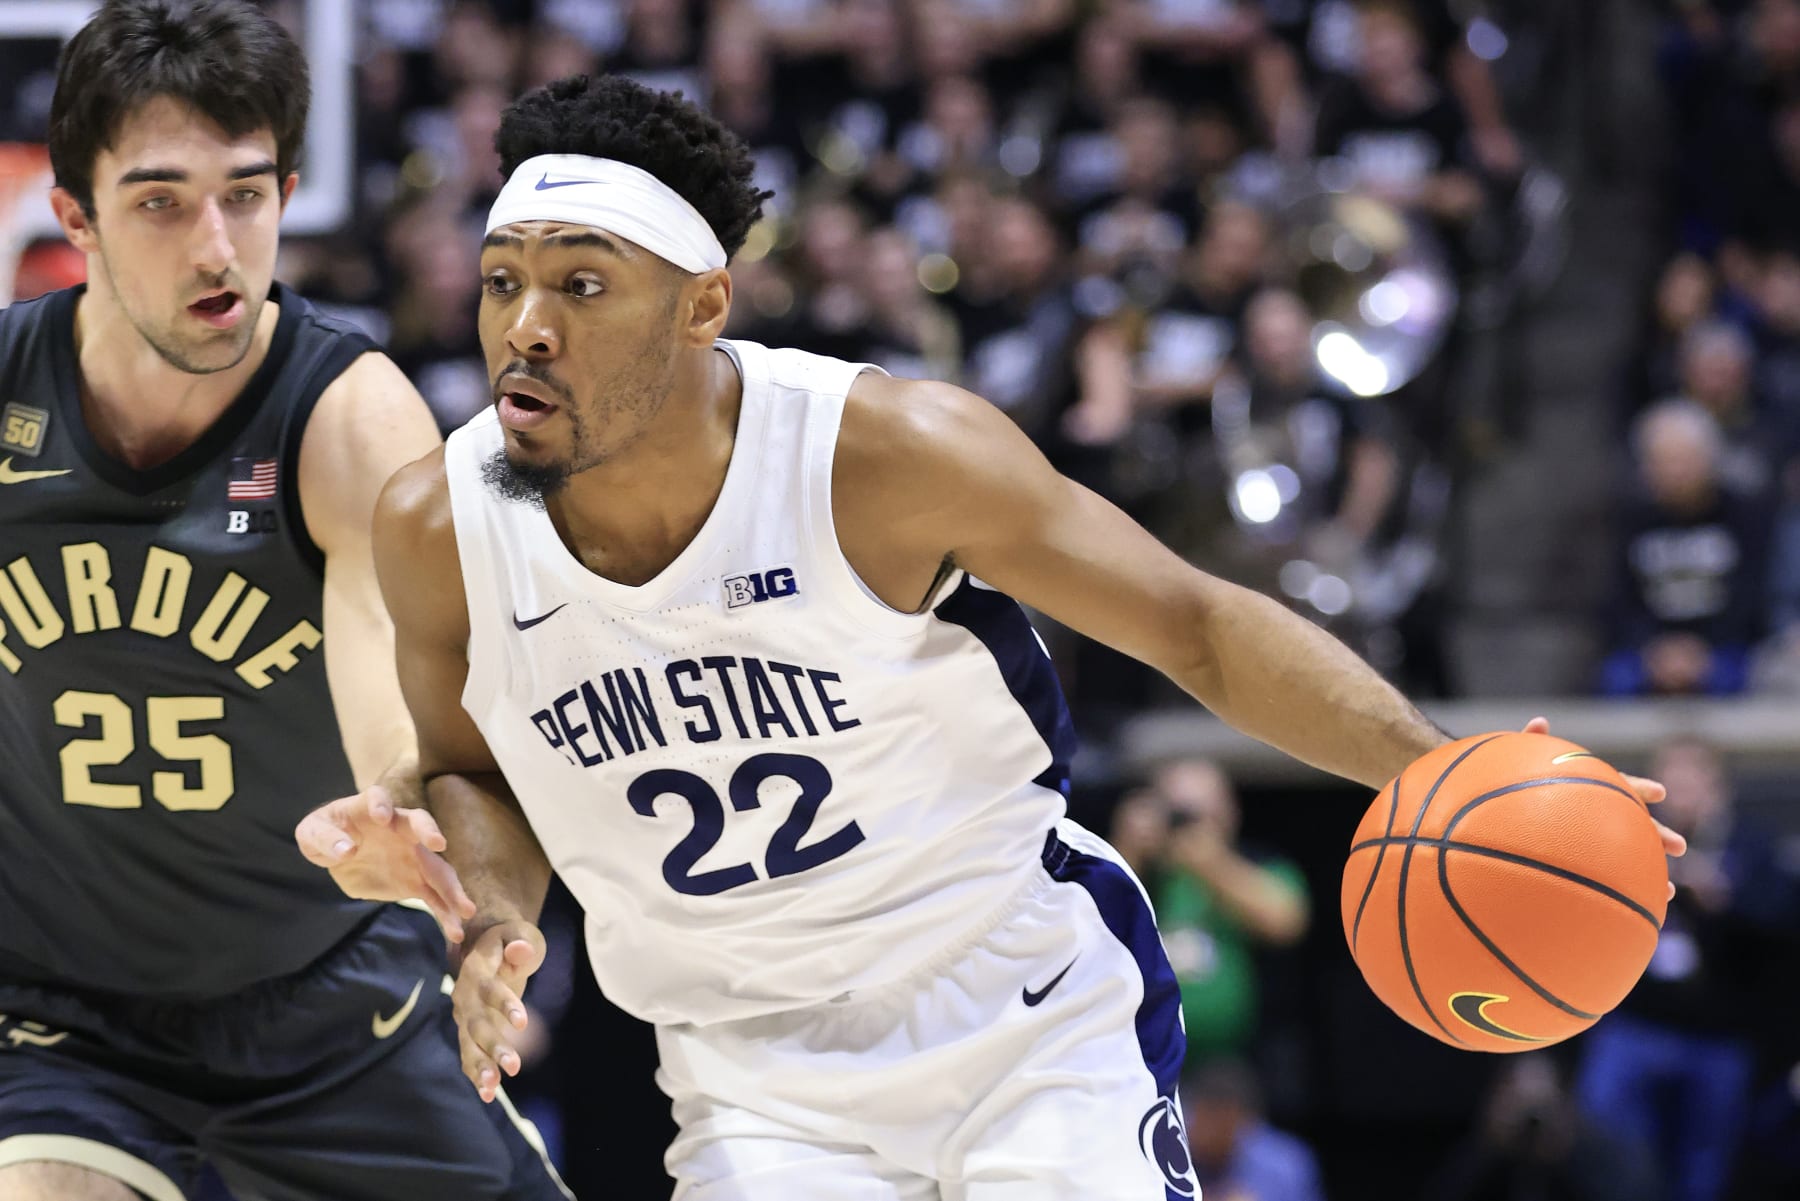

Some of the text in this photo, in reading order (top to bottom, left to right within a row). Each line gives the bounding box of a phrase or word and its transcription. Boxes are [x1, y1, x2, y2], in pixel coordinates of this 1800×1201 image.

[3, 415, 41, 448] 50
[53, 690, 235, 812] 25
[530, 655, 862, 768] PENN STATE
[627, 752, 867, 896] 22
